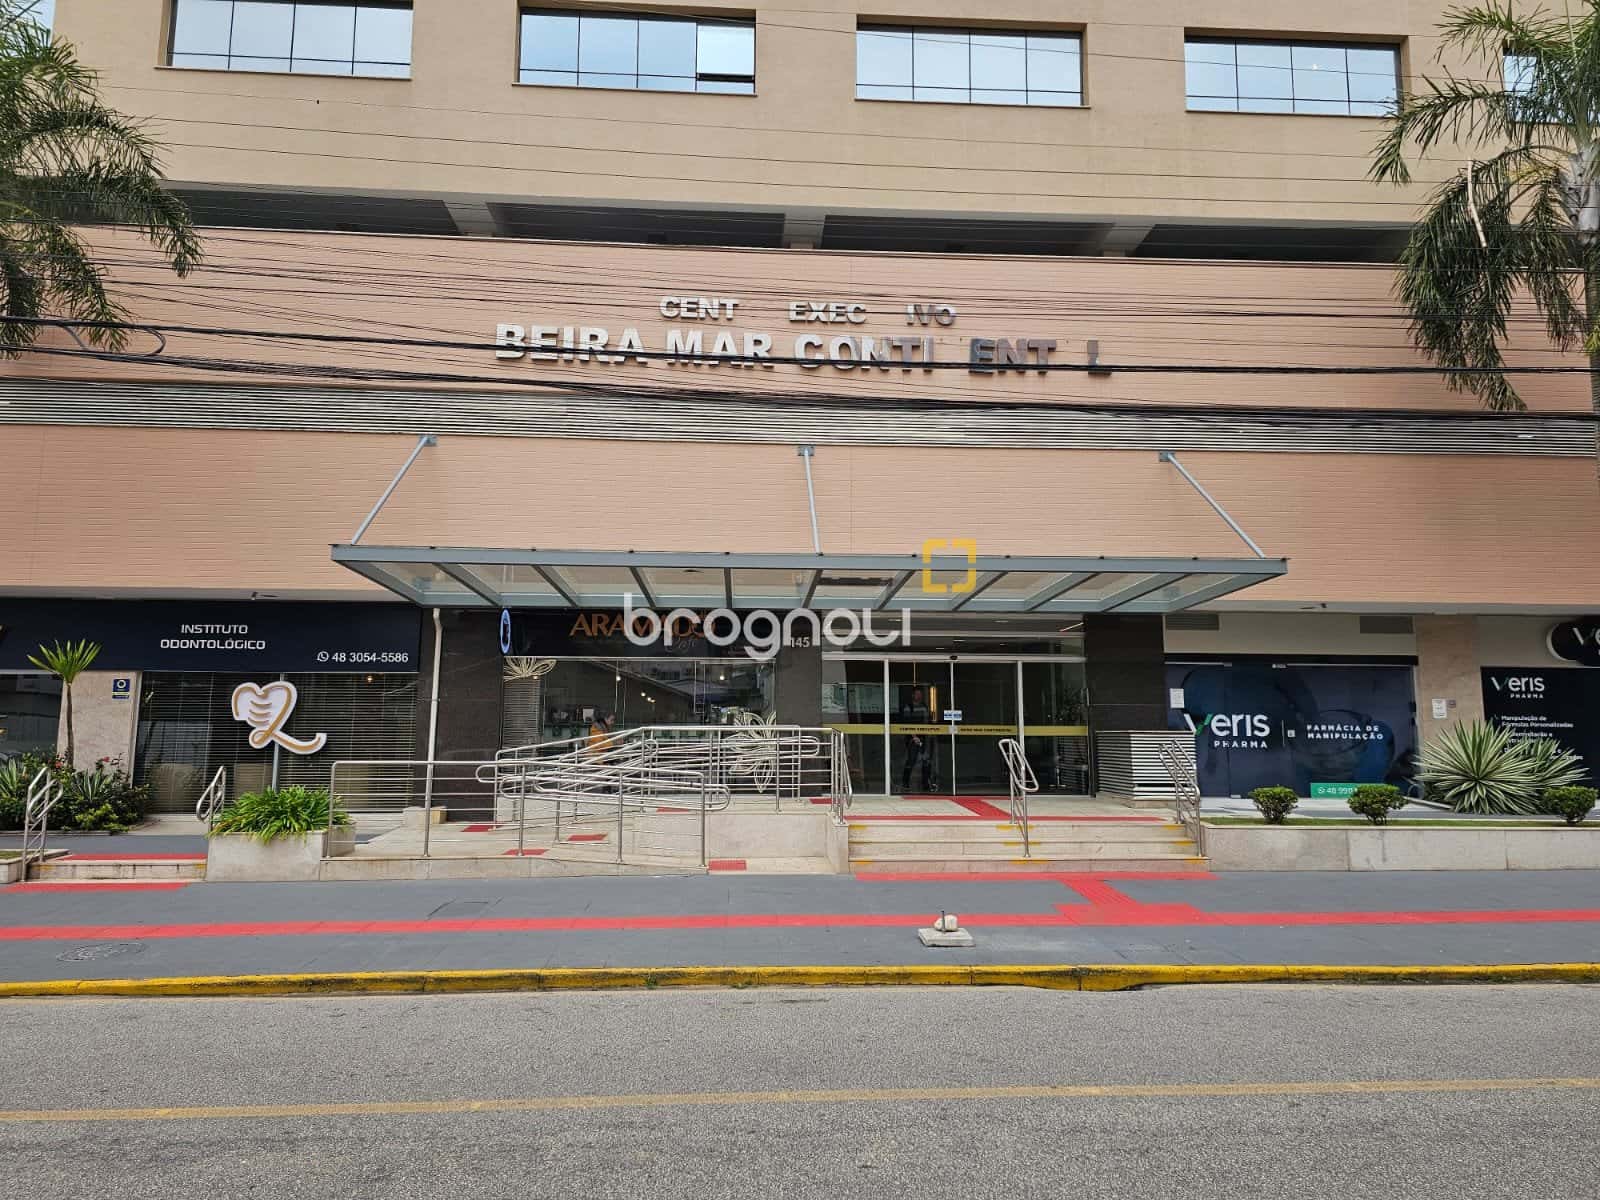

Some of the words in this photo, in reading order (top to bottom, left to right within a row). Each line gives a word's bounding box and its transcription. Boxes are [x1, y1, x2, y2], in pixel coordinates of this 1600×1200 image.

[495, 323, 648, 363] BEIRA
[665, 328, 775, 367] MAR
[180, 624, 248, 634] INSTITUTO
[160, 638, 266, 650] ODONTOLÓGICO
[790, 636, 811, 648] 145
[331, 652, 346, 663] 48
[349, 652, 409, 663] 3054-5586
[1306, 723, 1361, 732] FARMÁCIA
[1307, 732, 1384, 740] MANIPULAÇÃO
[1213, 740, 1268, 749] PHARMA
